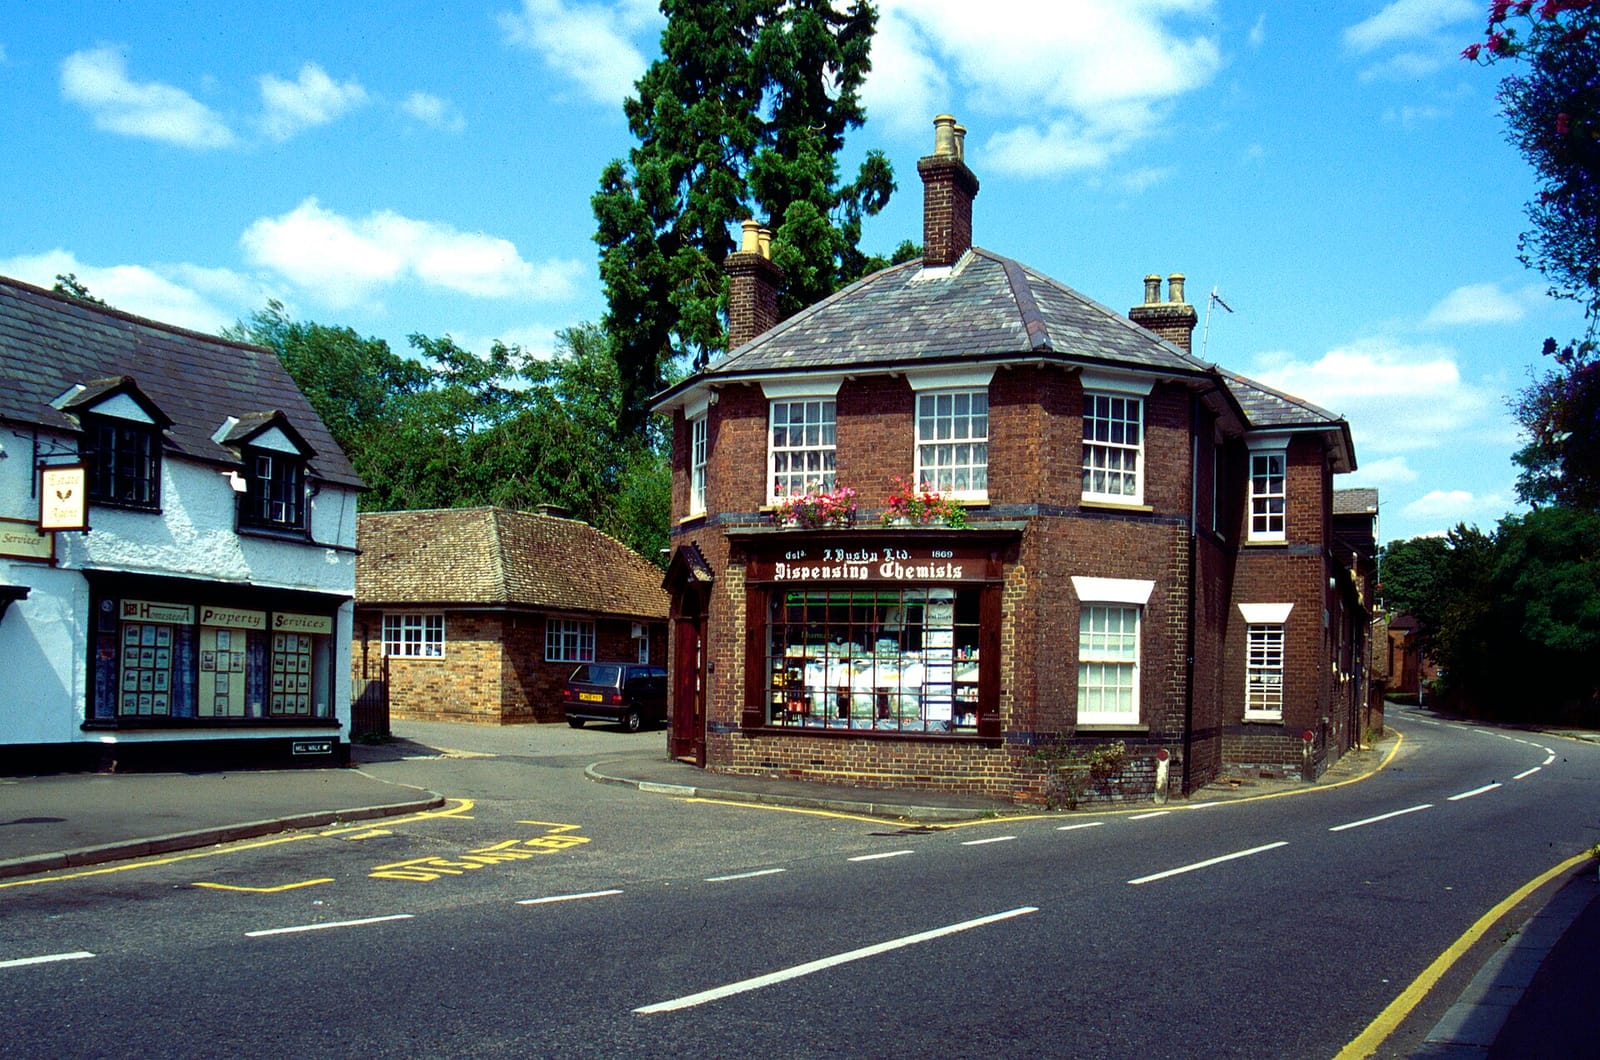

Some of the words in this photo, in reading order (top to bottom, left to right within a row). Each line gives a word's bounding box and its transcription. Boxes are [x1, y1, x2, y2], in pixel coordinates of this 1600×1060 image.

[2, 532, 41, 546] Services
[835, 548, 878, 563] Busby
[883, 548, 912, 561] Ltd.
[931, 550, 954, 559] 1869
[774, 561, 869, 581] Dispensing
[879, 561, 963, 580] Chemists
[202, 608, 261, 627] Property
[274, 614, 326, 629] Services
